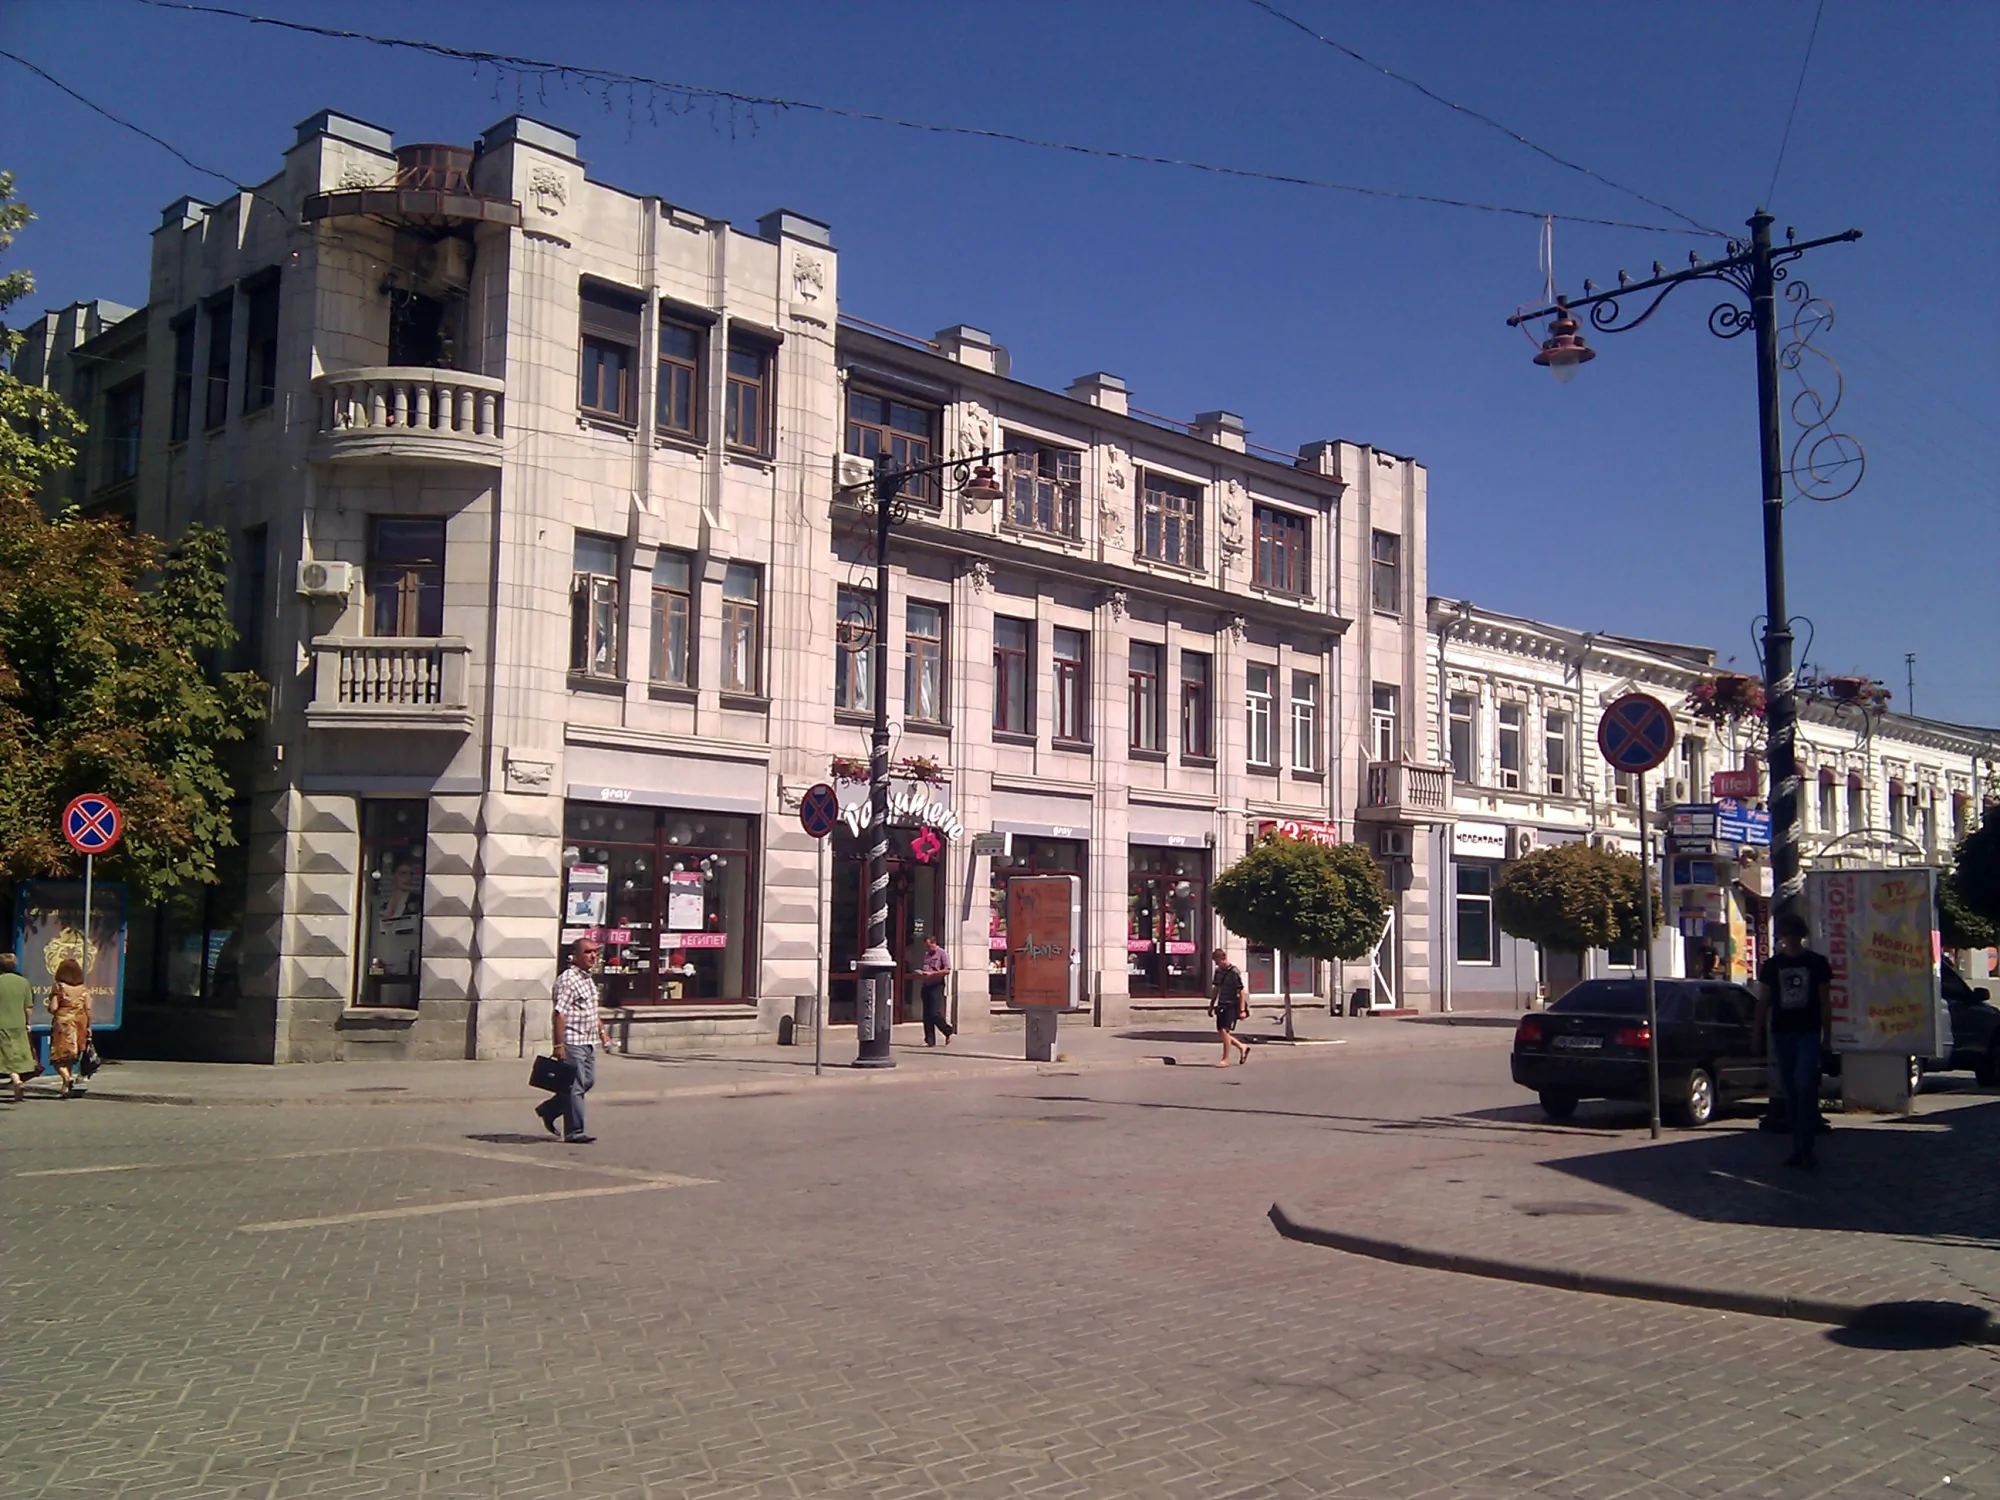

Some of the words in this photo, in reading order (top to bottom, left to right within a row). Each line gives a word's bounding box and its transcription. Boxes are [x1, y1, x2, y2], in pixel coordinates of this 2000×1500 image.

[601, 788, 632, 801] gray
[1052, 826, 1073, 837] gray
[1167, 835, 1186, 846] gray
[1456, 833, 1504, 846] ЧЕЛЕНТАНО
[687, 935, 725, 945] ЕГИПЕТ
